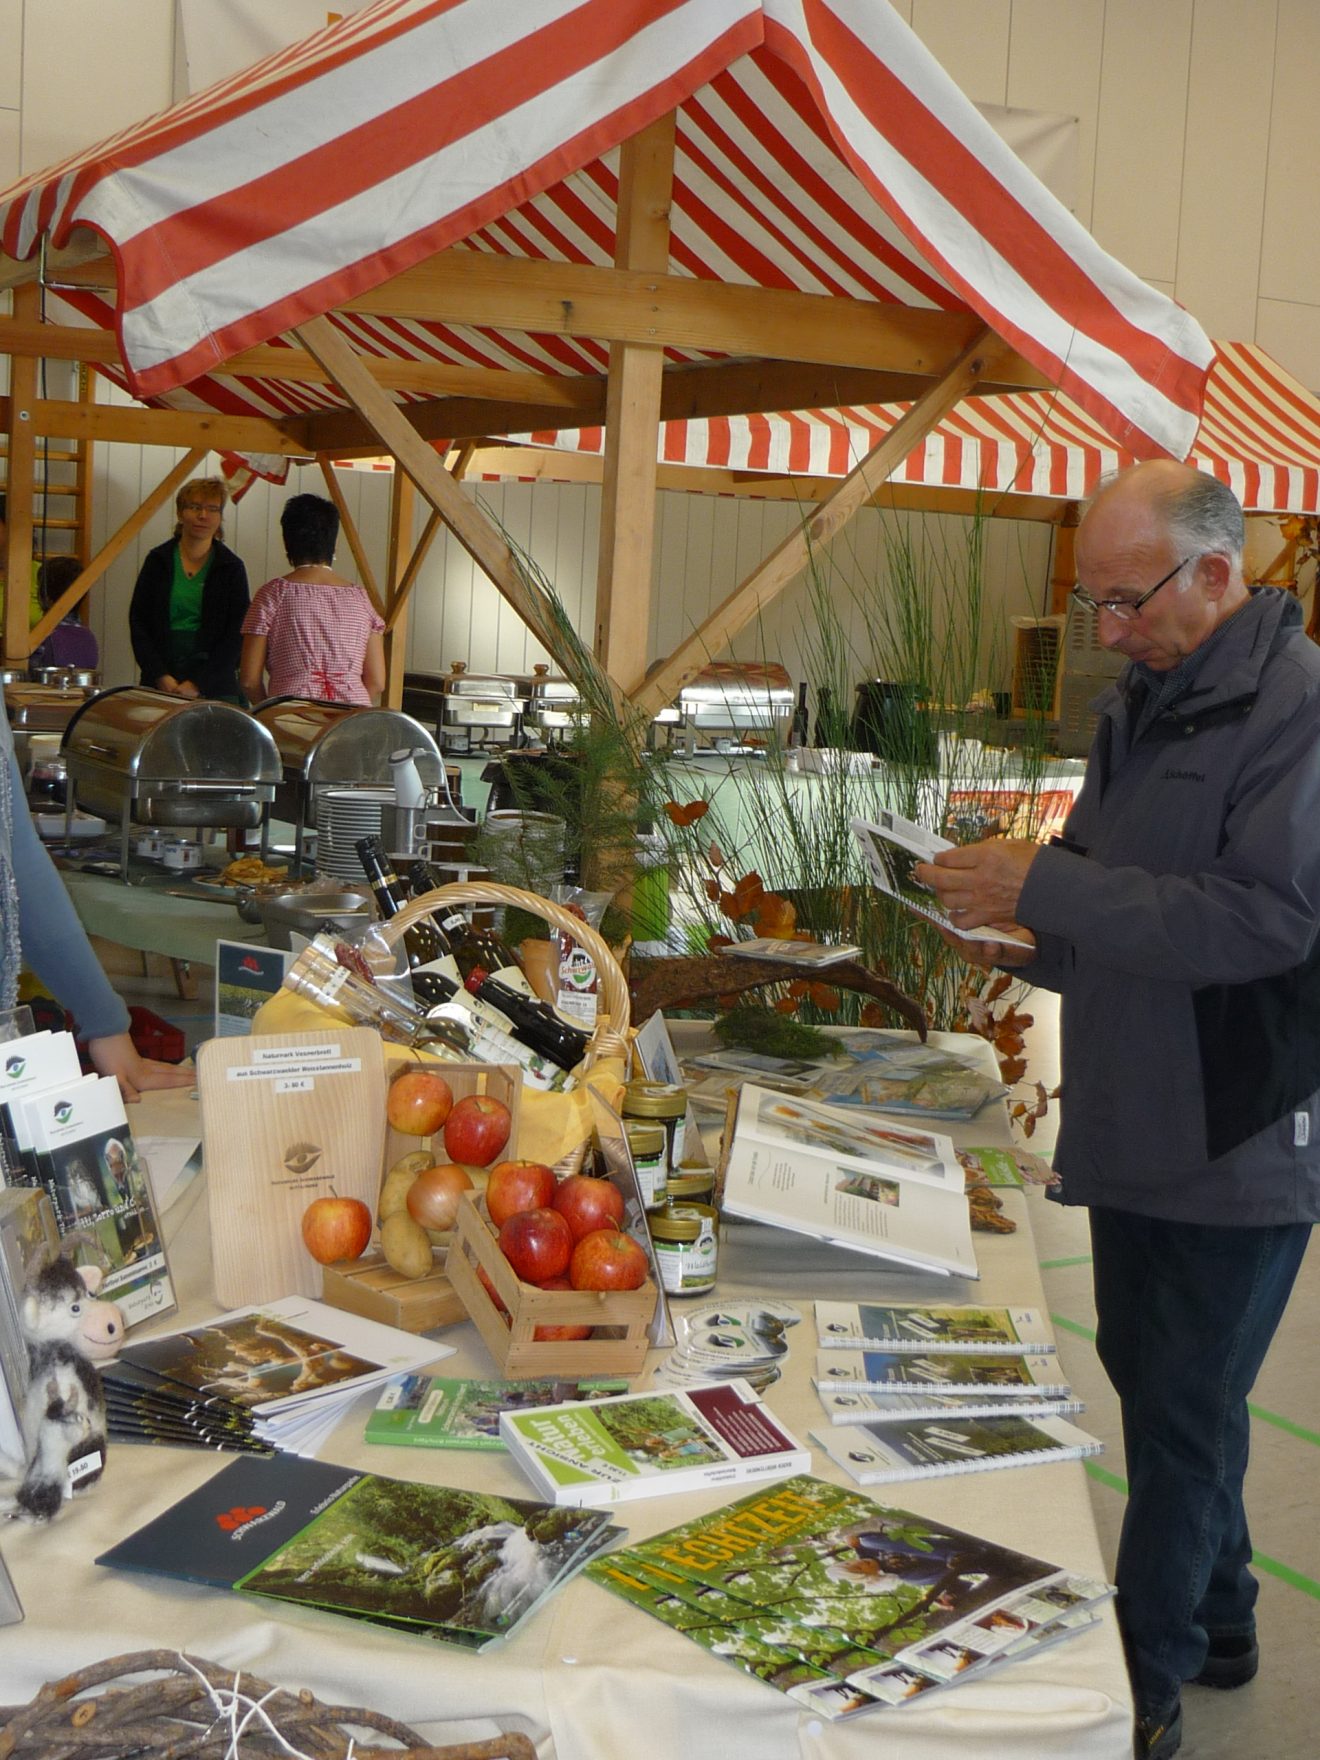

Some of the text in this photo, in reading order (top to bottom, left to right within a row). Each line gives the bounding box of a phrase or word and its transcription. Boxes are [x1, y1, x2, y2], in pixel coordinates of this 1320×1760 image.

[557, 1413, 608, 1460] erleben
[528, 1440, 622, 1484] ZUR ANSICHT
[661, 1490, 826, 1571] ECHTZEIT
